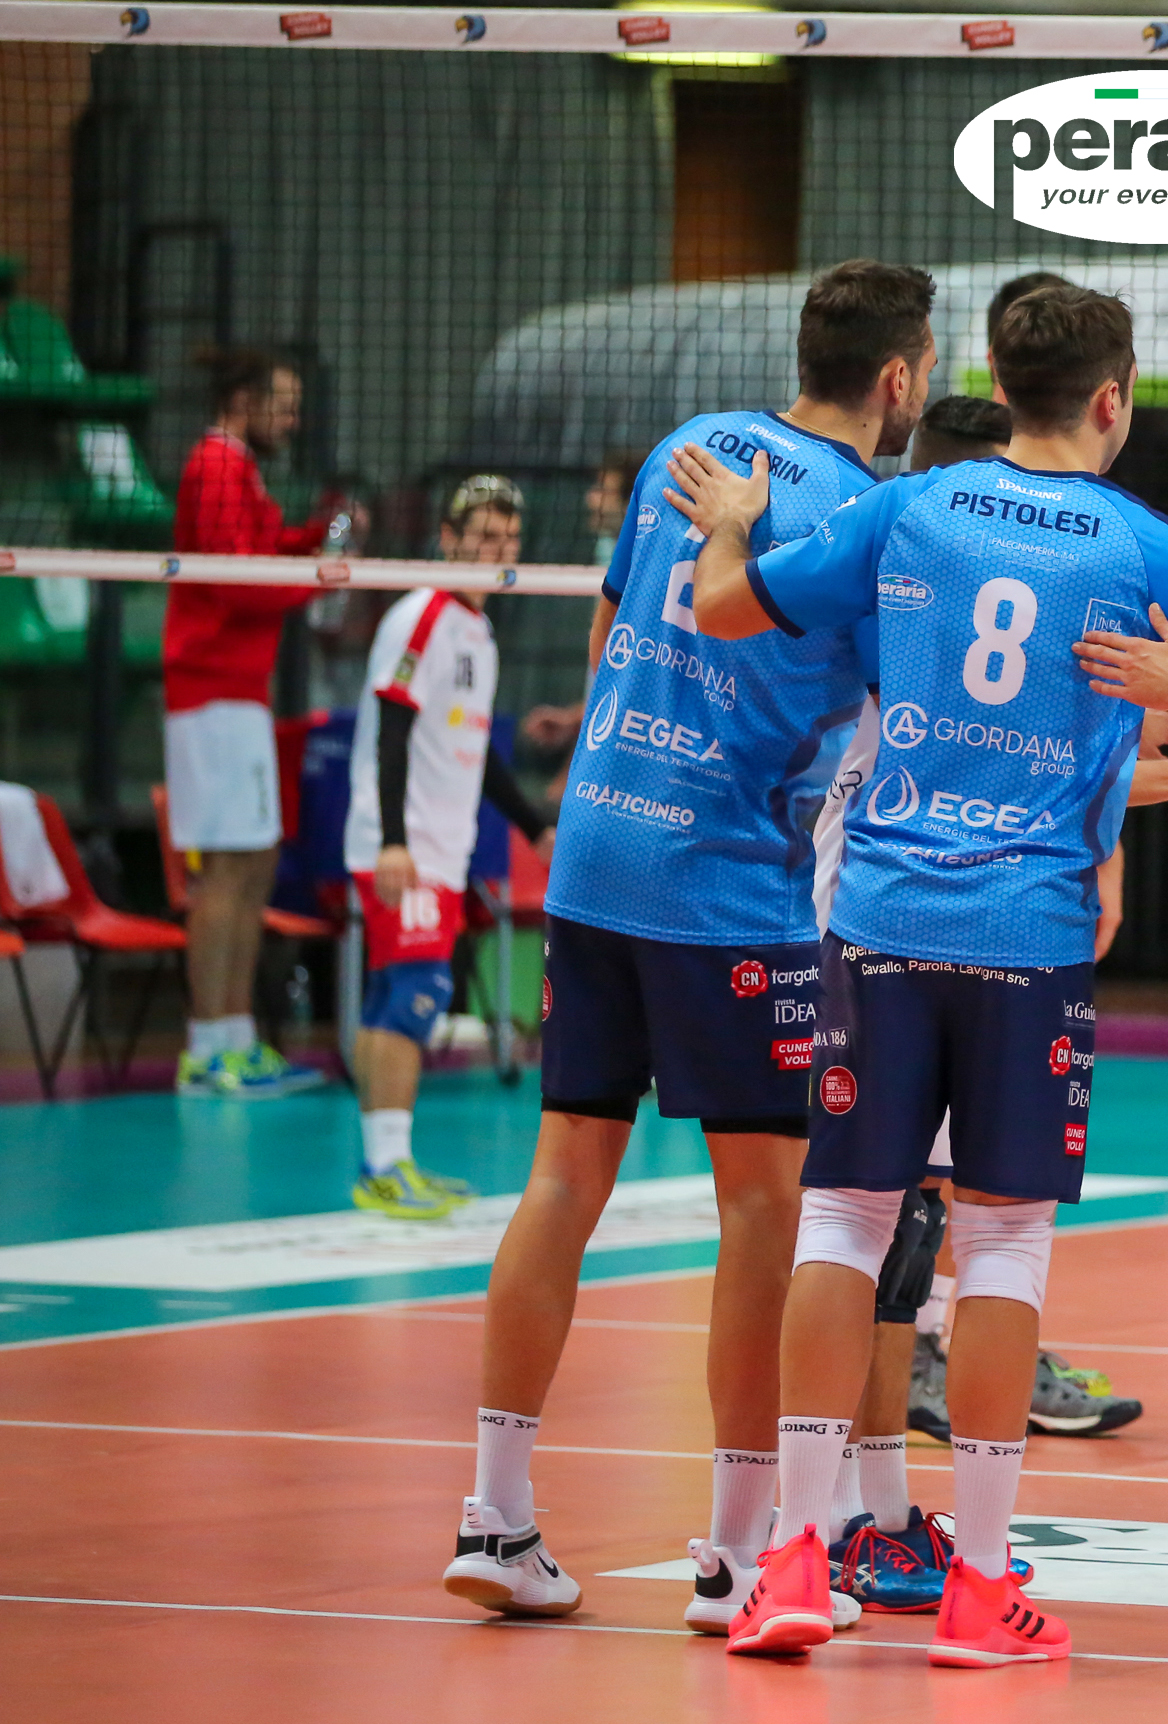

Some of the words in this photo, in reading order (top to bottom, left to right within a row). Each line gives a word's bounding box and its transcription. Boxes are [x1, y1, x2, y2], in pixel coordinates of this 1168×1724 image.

[746, 423, 801, 452] SPALDING
[706, 430, 809, 486] CODRIN
[996, 478, 1063, 502] SPALDING
[950, 491, 1101, 538] PISTOLESI
[962, 577, 1038, 705] 8
[636, 638, 736, 701] GIORDANA
[704, 689, 735, 712] roup
[619, 709, 725, 762] EGEA
[934, 717, 1076, 762] GIORDANA
[615, 742, 655, 760] ENERGIE
[656, 754, 668, 764] DEL
[670, 757, 732, 782] TERRITORIO
[1030, 761, 1075, 778] group
[576, 781, 695, 826] GRAFICUNEO
[927, 790, 1055, 835] EGEA
[923, 822, 969, 839] ENERGIE
[972, 833, 992, 844] DEL
[741, 971, 760, 986] CN
[861, 961, 905, 976] Cavallo,
[908, 960, 956, 973] Parola,
[959, 963, 1005, 980] Lavigna
[1006, 973, 1030, 987] snc
[774, 998, 796, 1006] rivista
[774, 1003, 816, 1024] IDEA
[830, 1029, 847, 1047] 186
[784, 1055, 812, 1065] VOLL
[1056, 1048, 1069, 1064] CN
[1071, 1048, 1095, 1070] targa
[826, 1095, 851, 1103] ITALIANI
[1068, 1087, 1090, 1109] IDEA
[1066, 1127, 1085, 1139] CUNEO
[1066, 1141, 1084, 1151] VOLL
[779, 1423, 828, 1435] LDING
